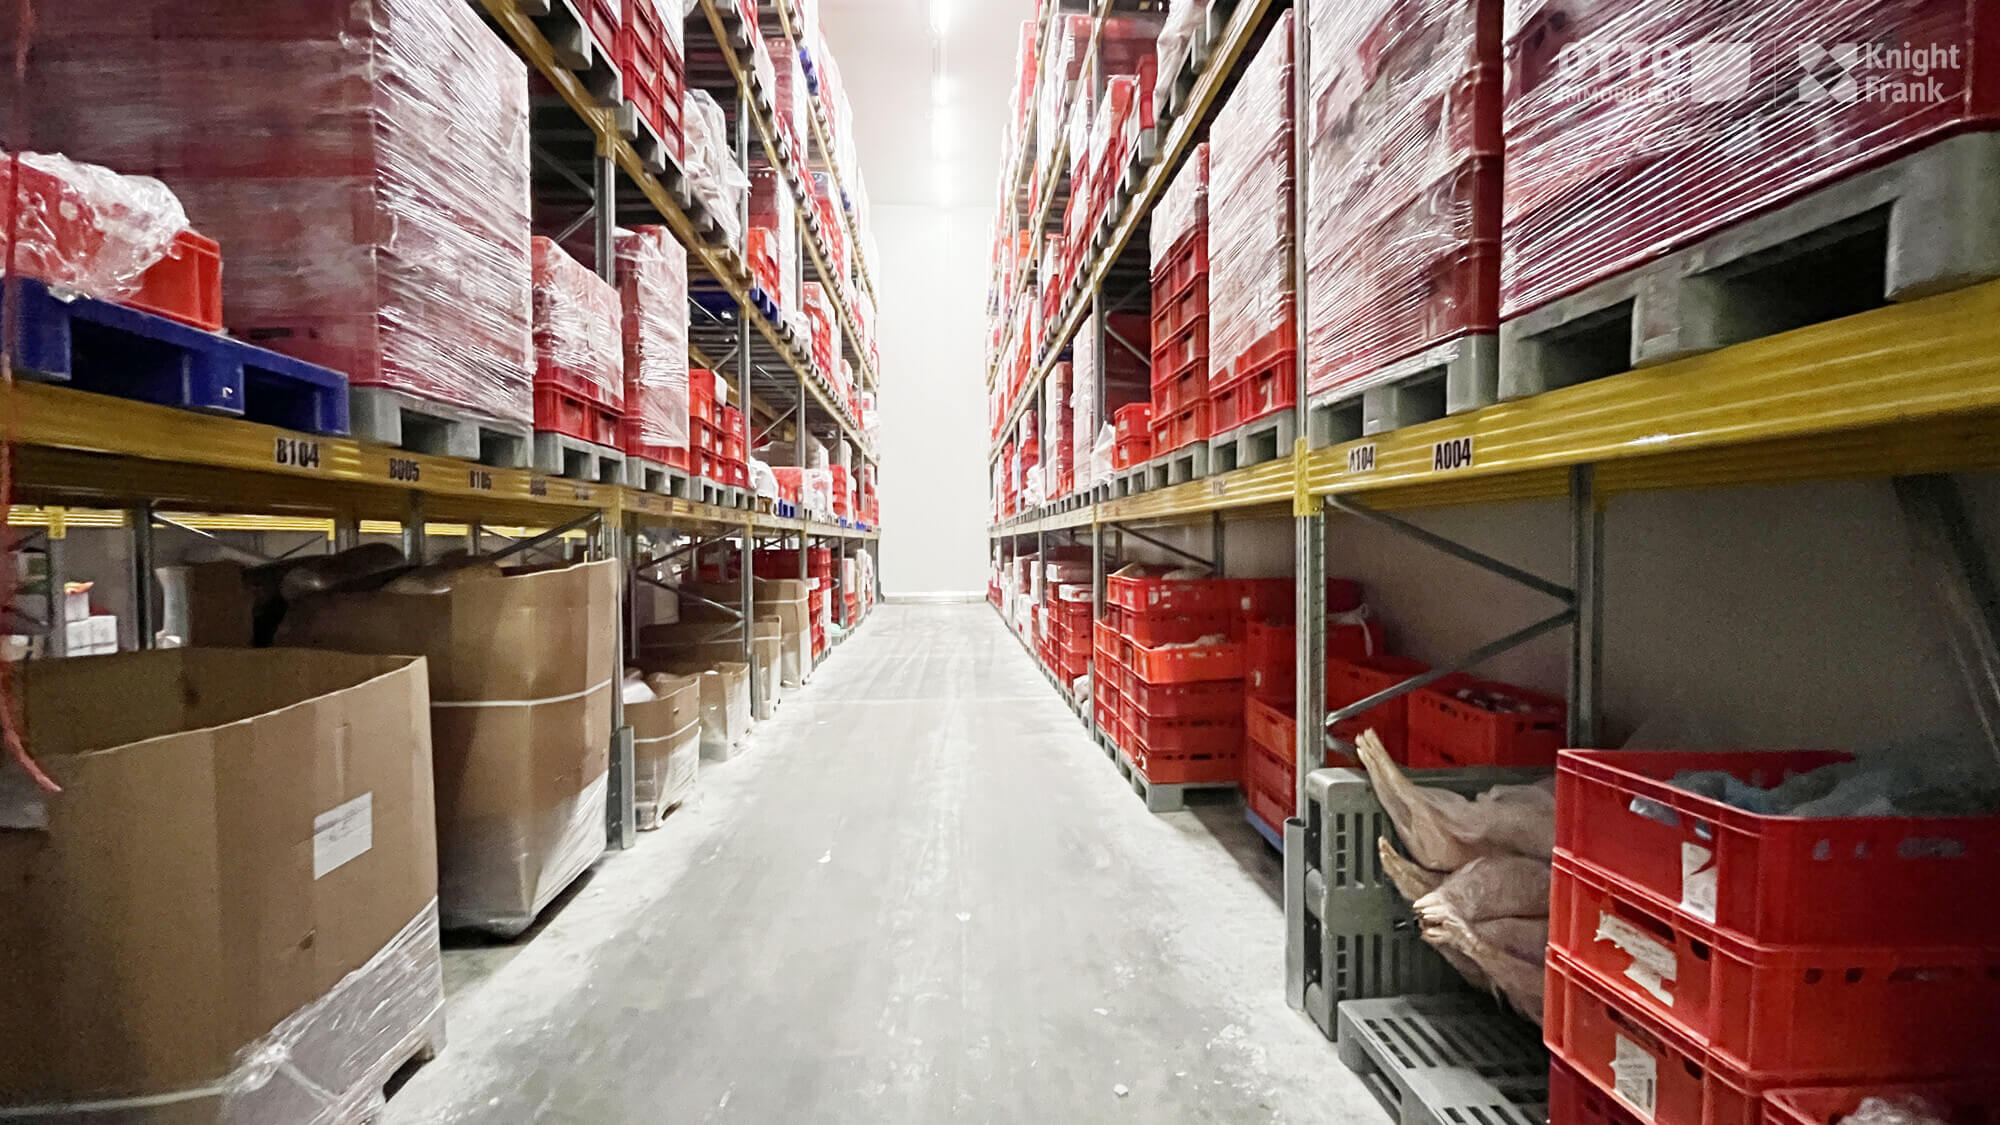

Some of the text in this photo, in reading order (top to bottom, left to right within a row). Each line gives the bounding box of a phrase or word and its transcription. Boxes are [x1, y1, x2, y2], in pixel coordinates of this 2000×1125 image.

[277, 438, 319, 468] B104
[1349, 446, 1374, 471] A104
[1435, 438, 1471, 471] A004
[389, 458, 420, 481] B005
